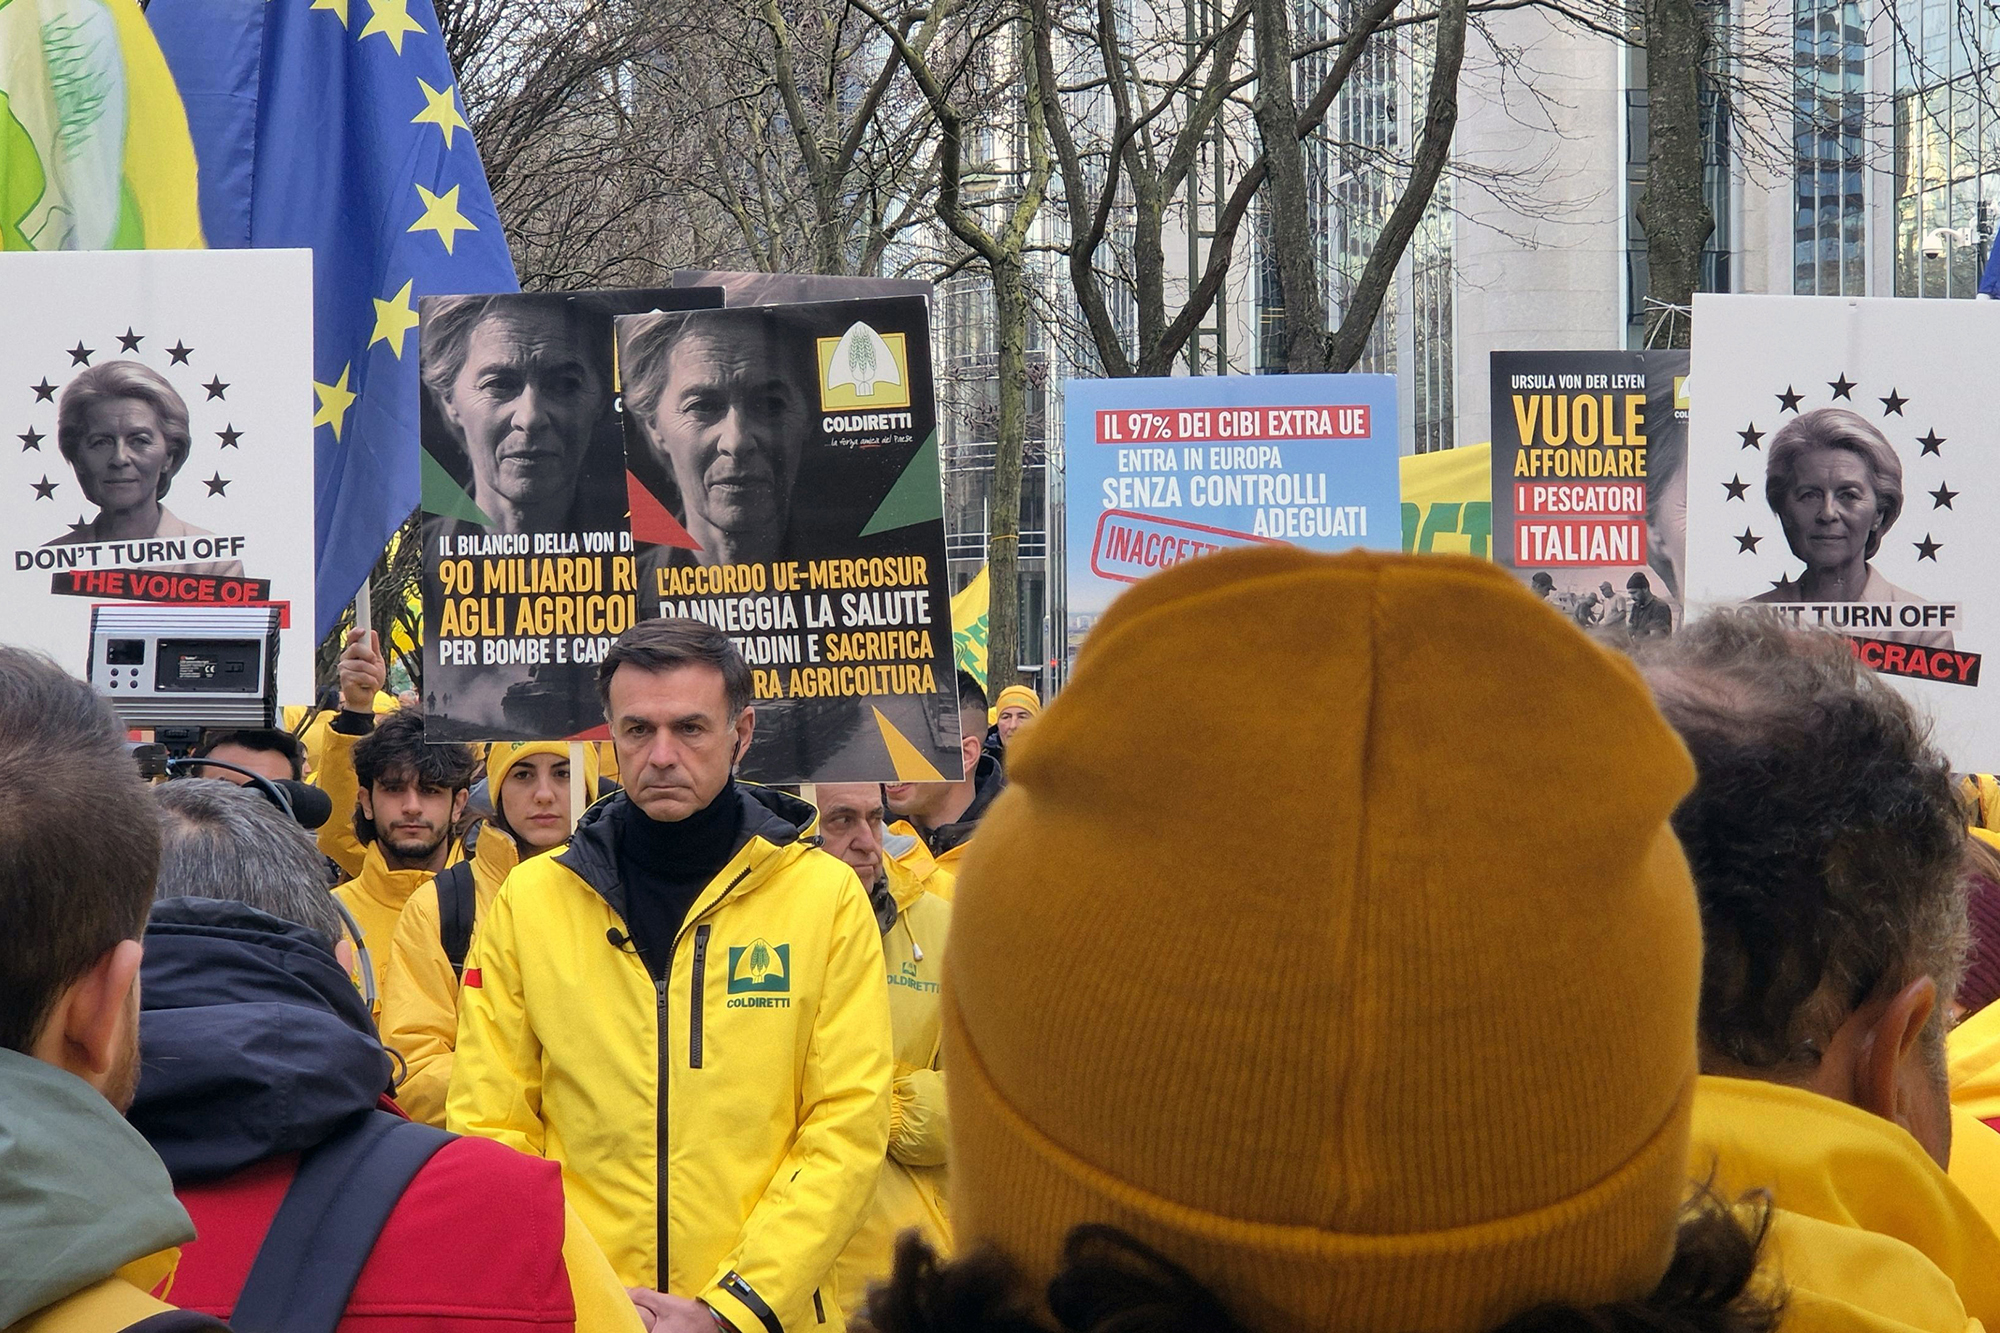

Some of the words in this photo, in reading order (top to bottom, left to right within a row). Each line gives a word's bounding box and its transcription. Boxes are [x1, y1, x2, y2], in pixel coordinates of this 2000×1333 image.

[1511, 374, 1556, 389] URSULA
[1560, 375, 1582, 389] VON
[1586, 375, 1608, 389] DER
[1612, 374, 1645, 389] LEYEN
[823, 413, 912, 433] COLDIRETTI
[1104, 415, 1122, 439] IL
[1128, 413, 1172, 439] 97%
[1179, 412, 1211, 437] DEI
[1218, 411, 1260, 437] CIBI
[1269, 410, 1332, 436] EXTRA
[1339, 409, 1365, 434] UE
[1512, 394, 1647, 446] VUOLE
[1119, 448, 1178, 473] ENTRA
[1184, 448, 1203, 470] IN
[1210, 446, 1282, 470] EUROPA
[1514, 449, 1647, 477] AFFONDARE
[1102, 475, 1182, 510] SENZA
[1190, 473, 1326, 507] CONTROLLI
[1519, 487, 1525, 511] I
[1534, 487, 1643, 511] PESCATORI
[1253, 506, 1367, 538] ADEGUATI
[15, 545, 102, 571] DON'T
[109, 540, 186, 564] TURN
[192, 536, 246, 558] OFF
[439, 536, 453, 556] IL
[458, 534, 529, 556] BILANCIO
[535, 533, 579, 554] DELLA
[583, 532, 614, 553] VON
[1520, 525, 1640, 561] ITALIANI
[69, 570, 124, 594] THE
[129, 574, 216, 602] VOICE
[221, 582, 260, 603] OF
[439, 560, 474, 595] 90
[484, 557, 602, 594] MILIARDI
[656, 563, 766, 596] L'ACCORDO
[772, 556, 929, 591] UE-MERCOSUR
[440, 597, 505, 637] AGLI
[804, 594, 835, 628] LA
[841, 590, 932, 628] SALUTE
[1812, 606, 1891, 628] TURN
[1899, 605, 1956, 628] OFF
[440, 640, 477, 665] PER
[483, 638, 550, 664] BOMBE
[556, 638, 567, 663] E
[729, 634, 801, 665] TADINI
[807, 634, 821, 662] E
[825, 630, 934, 663] SACRIFICA
[789, 664, 937, 698] AGRICOLTURA
[727, 997, 790, 1008] COLDIRETTI
